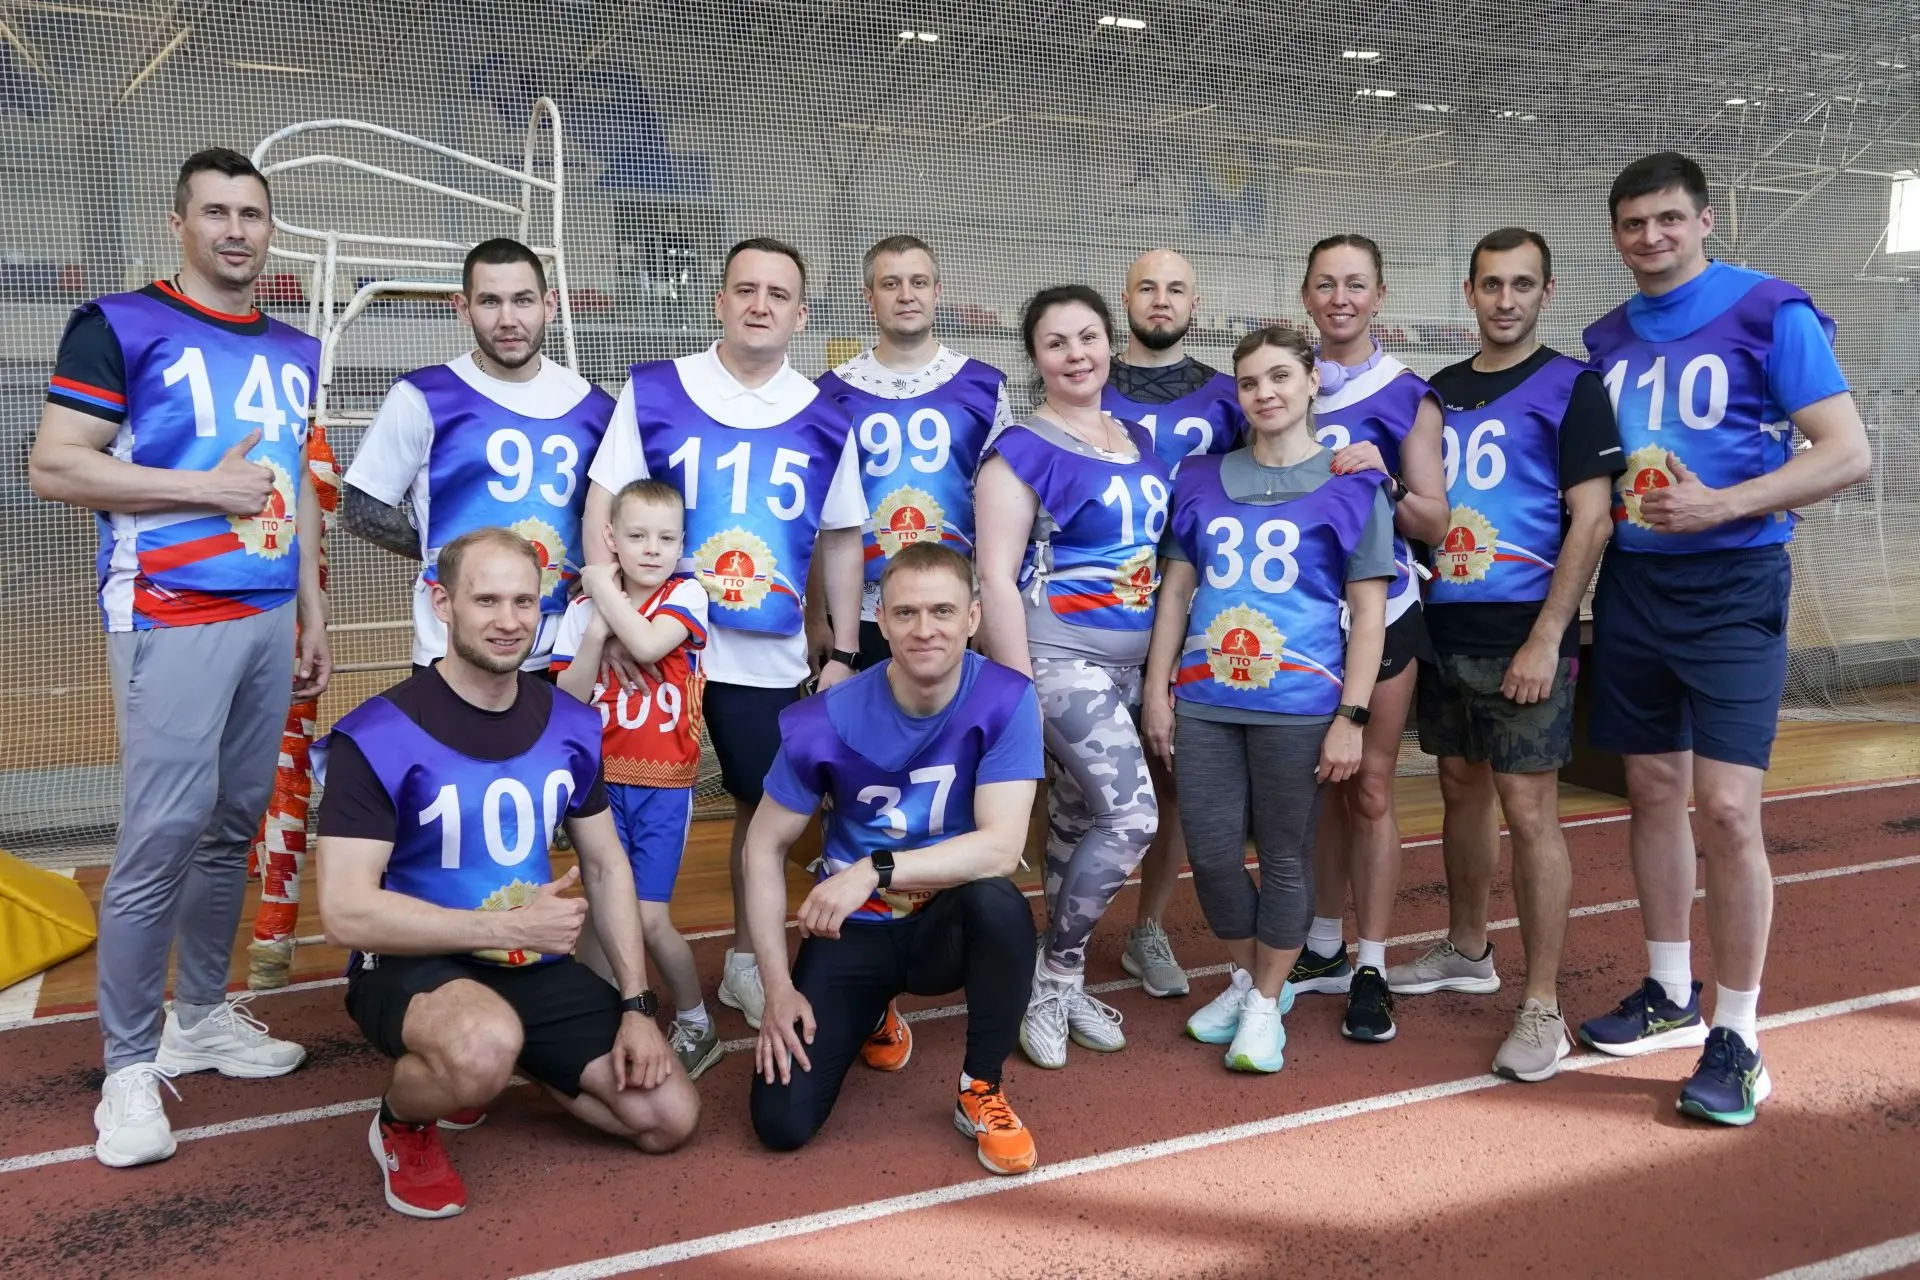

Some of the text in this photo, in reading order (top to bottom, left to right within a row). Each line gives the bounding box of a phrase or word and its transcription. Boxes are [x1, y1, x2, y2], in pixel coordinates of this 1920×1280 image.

[1603, 354, 1729, 430] 110
[486, 428, 579, 508] 93
[859, 408, 951, 477] 99
[668, 437, 810, 521] 115
[1102, 474, 1168, 545] 18
[262, 520, 278, 531] ГТО
[898, 531, 917, 540] ГТО
[1206, 516, 1300, 593] 38
[1451, 553, 1468, 562] ГТО
[723, 578, 744, 587] ГТО
[1229, 656, 1250, 666] ГТО
[418, 769, 576, 869] 100
[856, 764, 957, 840] 37
